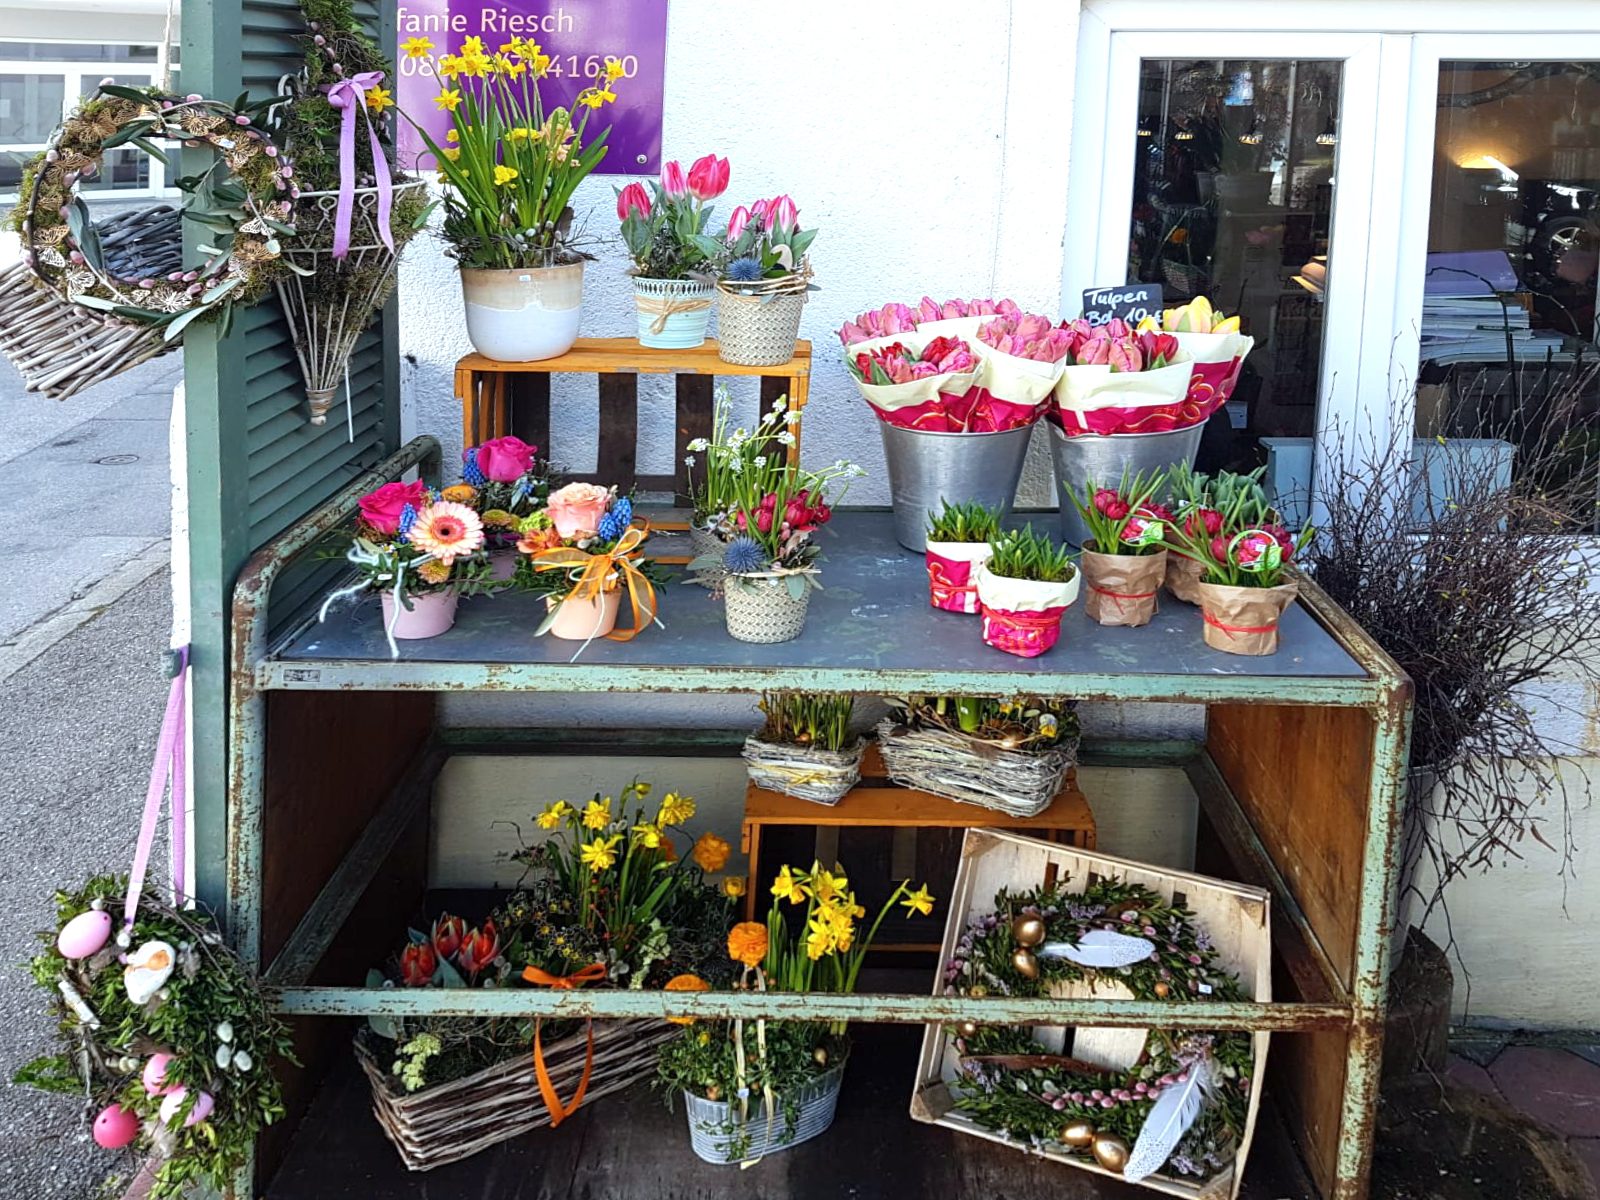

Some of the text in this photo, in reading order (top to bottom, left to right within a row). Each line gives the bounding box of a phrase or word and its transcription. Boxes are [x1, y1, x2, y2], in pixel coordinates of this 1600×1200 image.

[397, 7, 573, 33] fanie Riesch
[1084, 288, 1148, 309] Tulpen
